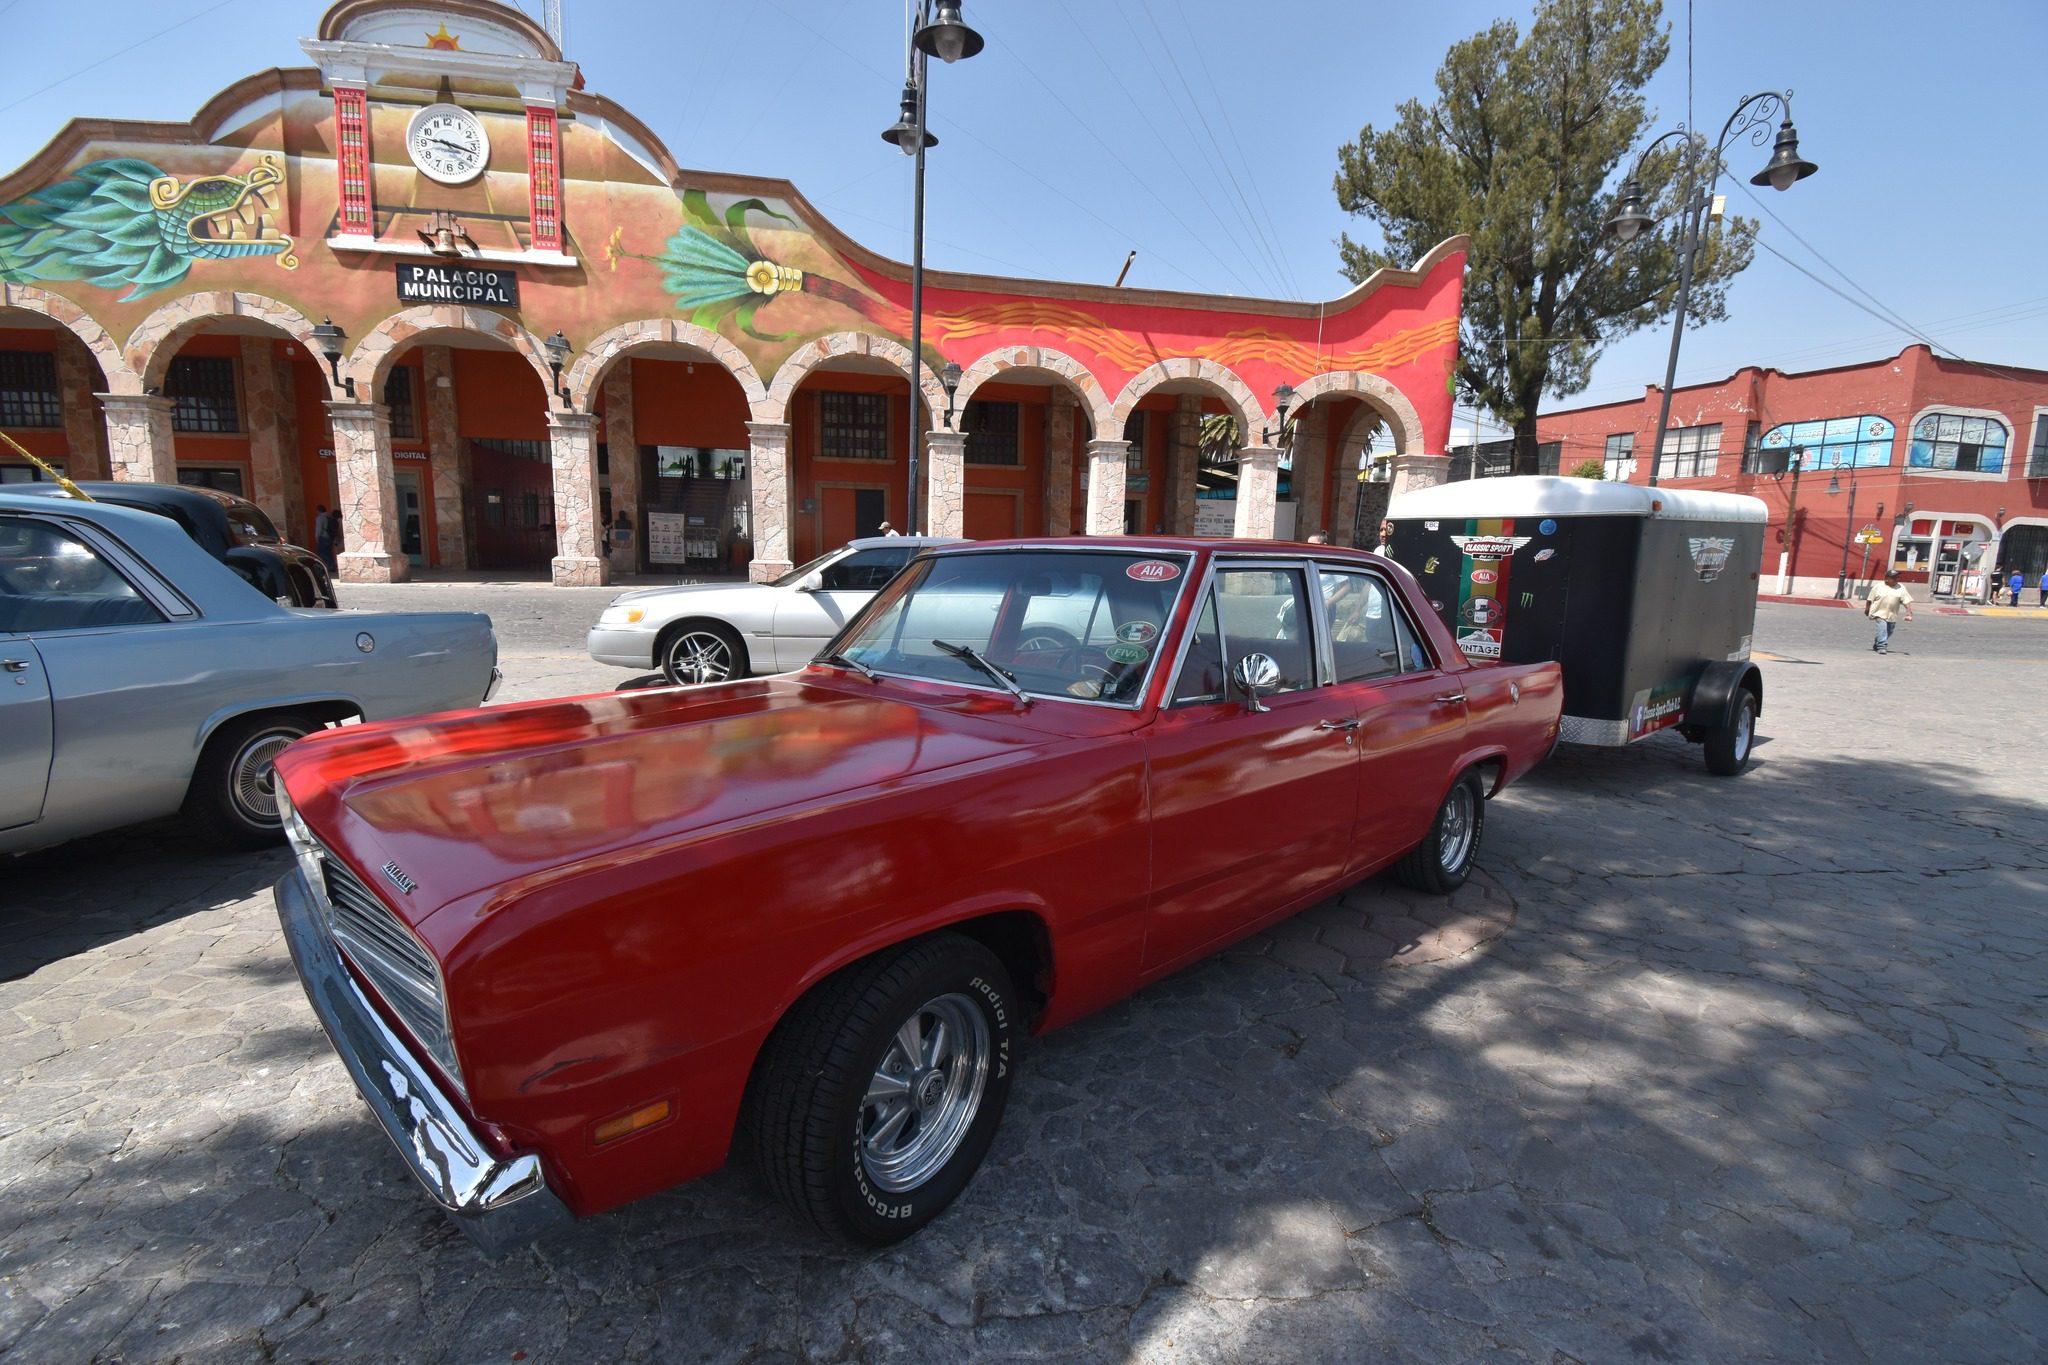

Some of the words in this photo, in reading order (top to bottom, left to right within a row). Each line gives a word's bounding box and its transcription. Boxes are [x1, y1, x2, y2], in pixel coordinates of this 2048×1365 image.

[433, 120, 439, 128] 11
[443, 118, 452, 126] 12
[458, 122, 461, 130] 1
[424, 128, 432, 136] 10
[466, 131, 472, 139] 2
[420, 139, 427, 147] 9
[470, 143, 477, 151] 3
[425, 151, 432, 159] 8
[467, 154, 473, 162] 4
[435, 160, 441, 168] 7
[446, 164, 453, 172] 6
[458, 162, 464, 170] 5
[413, 267, 498, 286] PALACIO
[404, 282, 509, 302] MUNICIPAL
[394, 452, 427, 460] DIGITAL
[1490, 544, 1512, 552] SPORT
[1140, 565, 1164, 576] AIA
[1113, 648, 1139, 658] FIVA
[384, 859, 416, 891] VALIANT
[969, 977, 1008, 1029] Radial
[997, 1038, 1009, 1079] T/A
